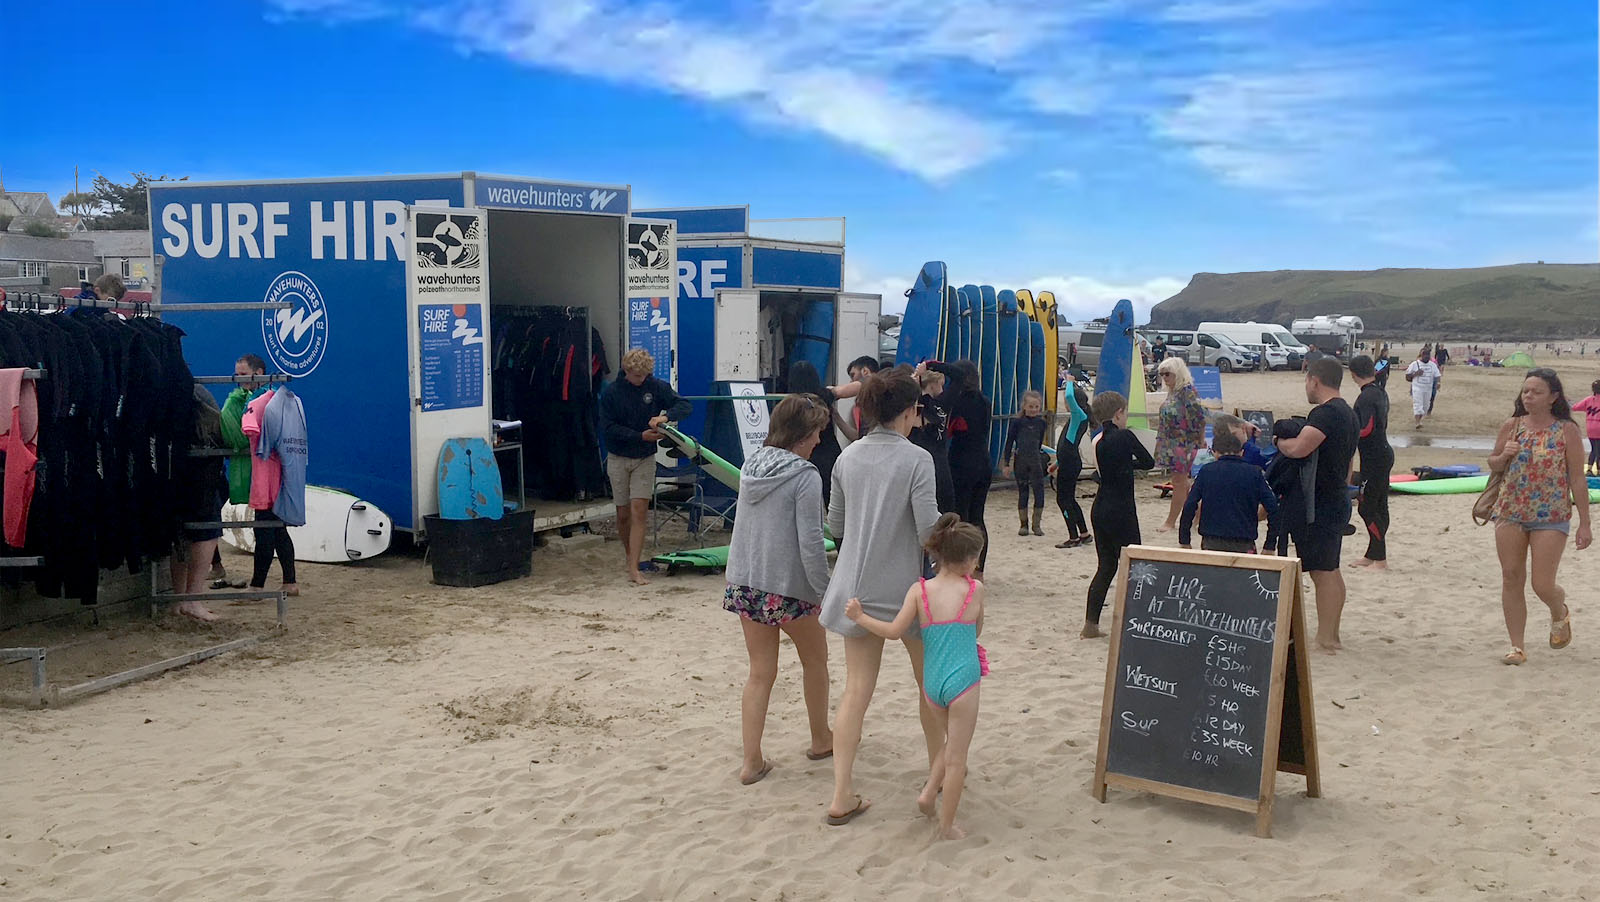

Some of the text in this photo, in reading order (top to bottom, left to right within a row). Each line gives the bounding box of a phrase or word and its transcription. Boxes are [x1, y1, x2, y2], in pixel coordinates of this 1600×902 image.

[487, 185, 583, 209] wavehunters
[161, 199, 450, 262] SURF HIR
[417, 272, 481, 285] wavehunters
[628, 273, 670, 284] wavehunters
[267, 277, 320, 309] WAVEHUNTERS
[418, 286, 481, 294] polzeathnorthcornwall
[423, 308, 450, 321] SURF
[631, 301, 649, 312] SURF
[265, 318, 273, 327] 20
[631, 311, 648, 321] HIRE
[315, 321, 324, 330] 02
[423, 321, 448, 333] HIRE
[279, 355, 298, 370] marine
[299, 336, 322, 369] adventures
[1167, 574, 1208, 601] HIRE
[1148, 595, 1165, 614] AT
[1126, 617, 1197, 645] SURFBOARD
[1126, 664, 1178, 695] WETSUIT
[1231, 678, 1260, 697] WEEK
[1221, 698, 1239, 716] HR
[1222, 719, 1246, 735] DAY
[1222, 737, 1254, 757] WEEK
[1205, 753, 1219, 767] HR
